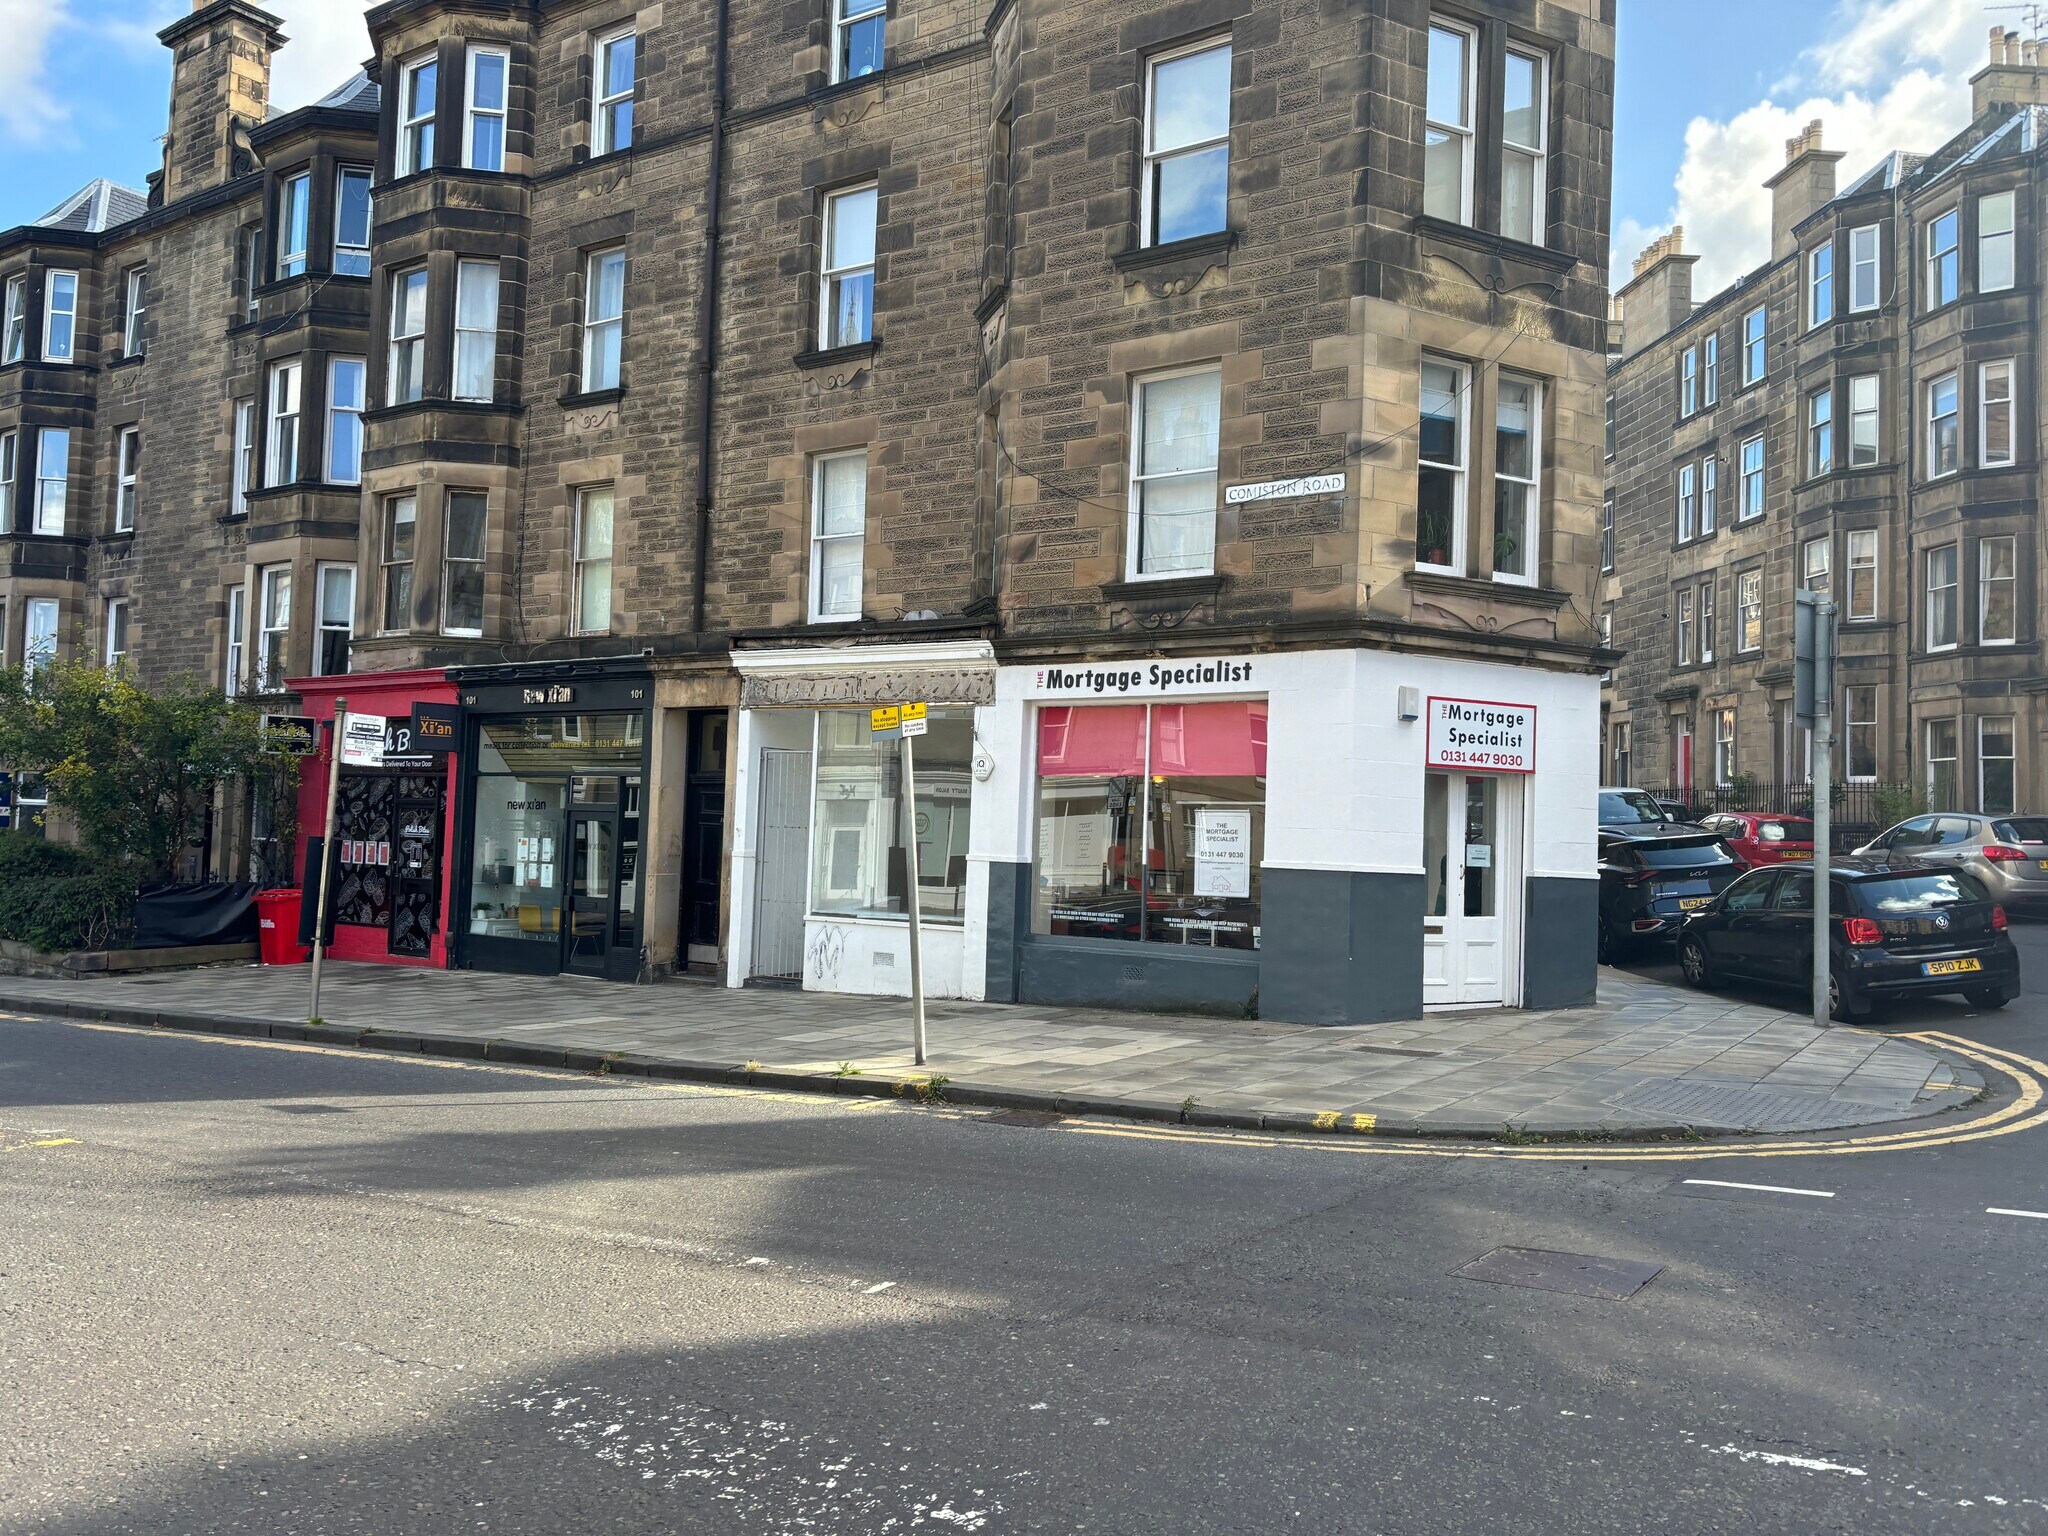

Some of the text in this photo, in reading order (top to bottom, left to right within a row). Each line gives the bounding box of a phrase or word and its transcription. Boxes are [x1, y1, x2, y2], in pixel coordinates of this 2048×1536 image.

[1229, 477, 1341, 500] COMISTON ROAD
[1046, 669, 1142, 693] Mortgage
[1150, 660, 1252, 690] Specialist
[466, 696, 477, 704] 101
[631, 690, 644, 699] 101
[1448, 704, 1524, 728] Mortgage
[1449, 727, 1522, 748] Specialist
[1441, 750, 1522, 766] 0131 447 9030
[507, 801, 524, 810] new
[1932, 960, 1977, 972] SP10 ZJK
